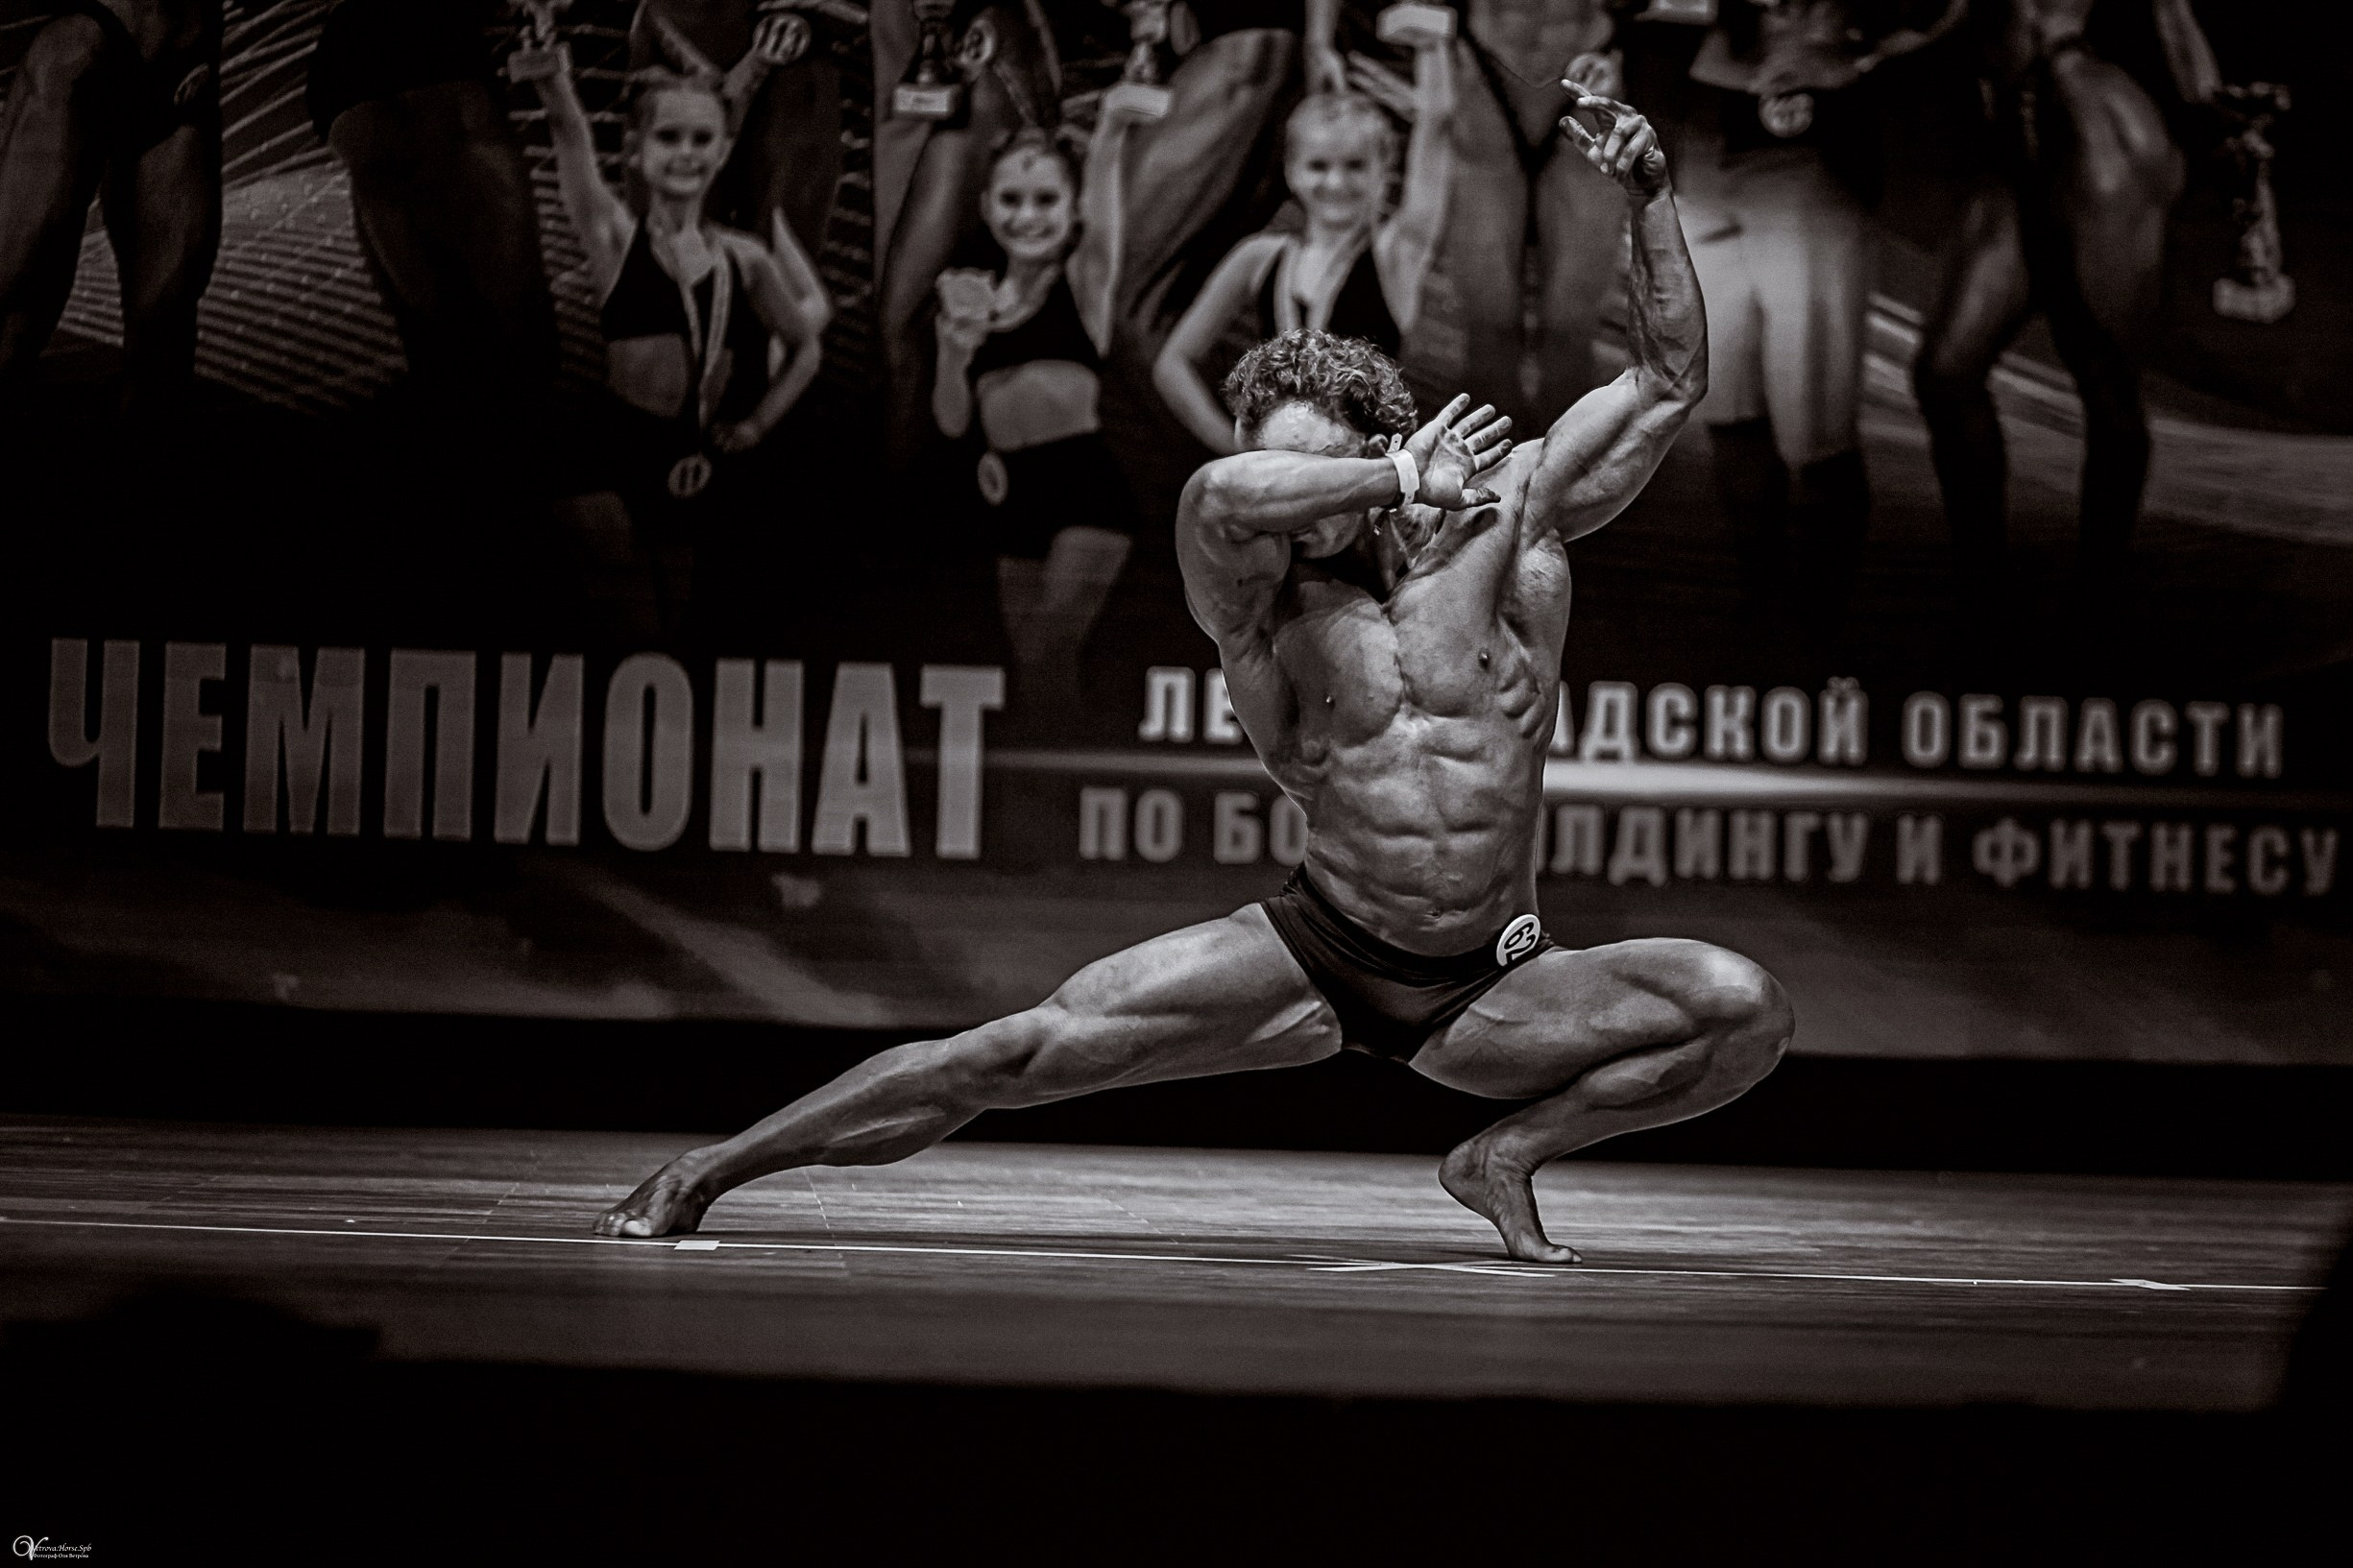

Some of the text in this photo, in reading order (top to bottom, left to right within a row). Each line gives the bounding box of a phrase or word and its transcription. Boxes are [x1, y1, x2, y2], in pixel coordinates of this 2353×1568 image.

[48, 638, 1006, 859] ЧЕМПИОНАТ
[1137, 665, 2284, 779] ЛЕДСКОЙ ОБЛАСТИ
[1079, 786, 2340, 896] ПО БОЛДИНГУ И ФИТНЕСУ
